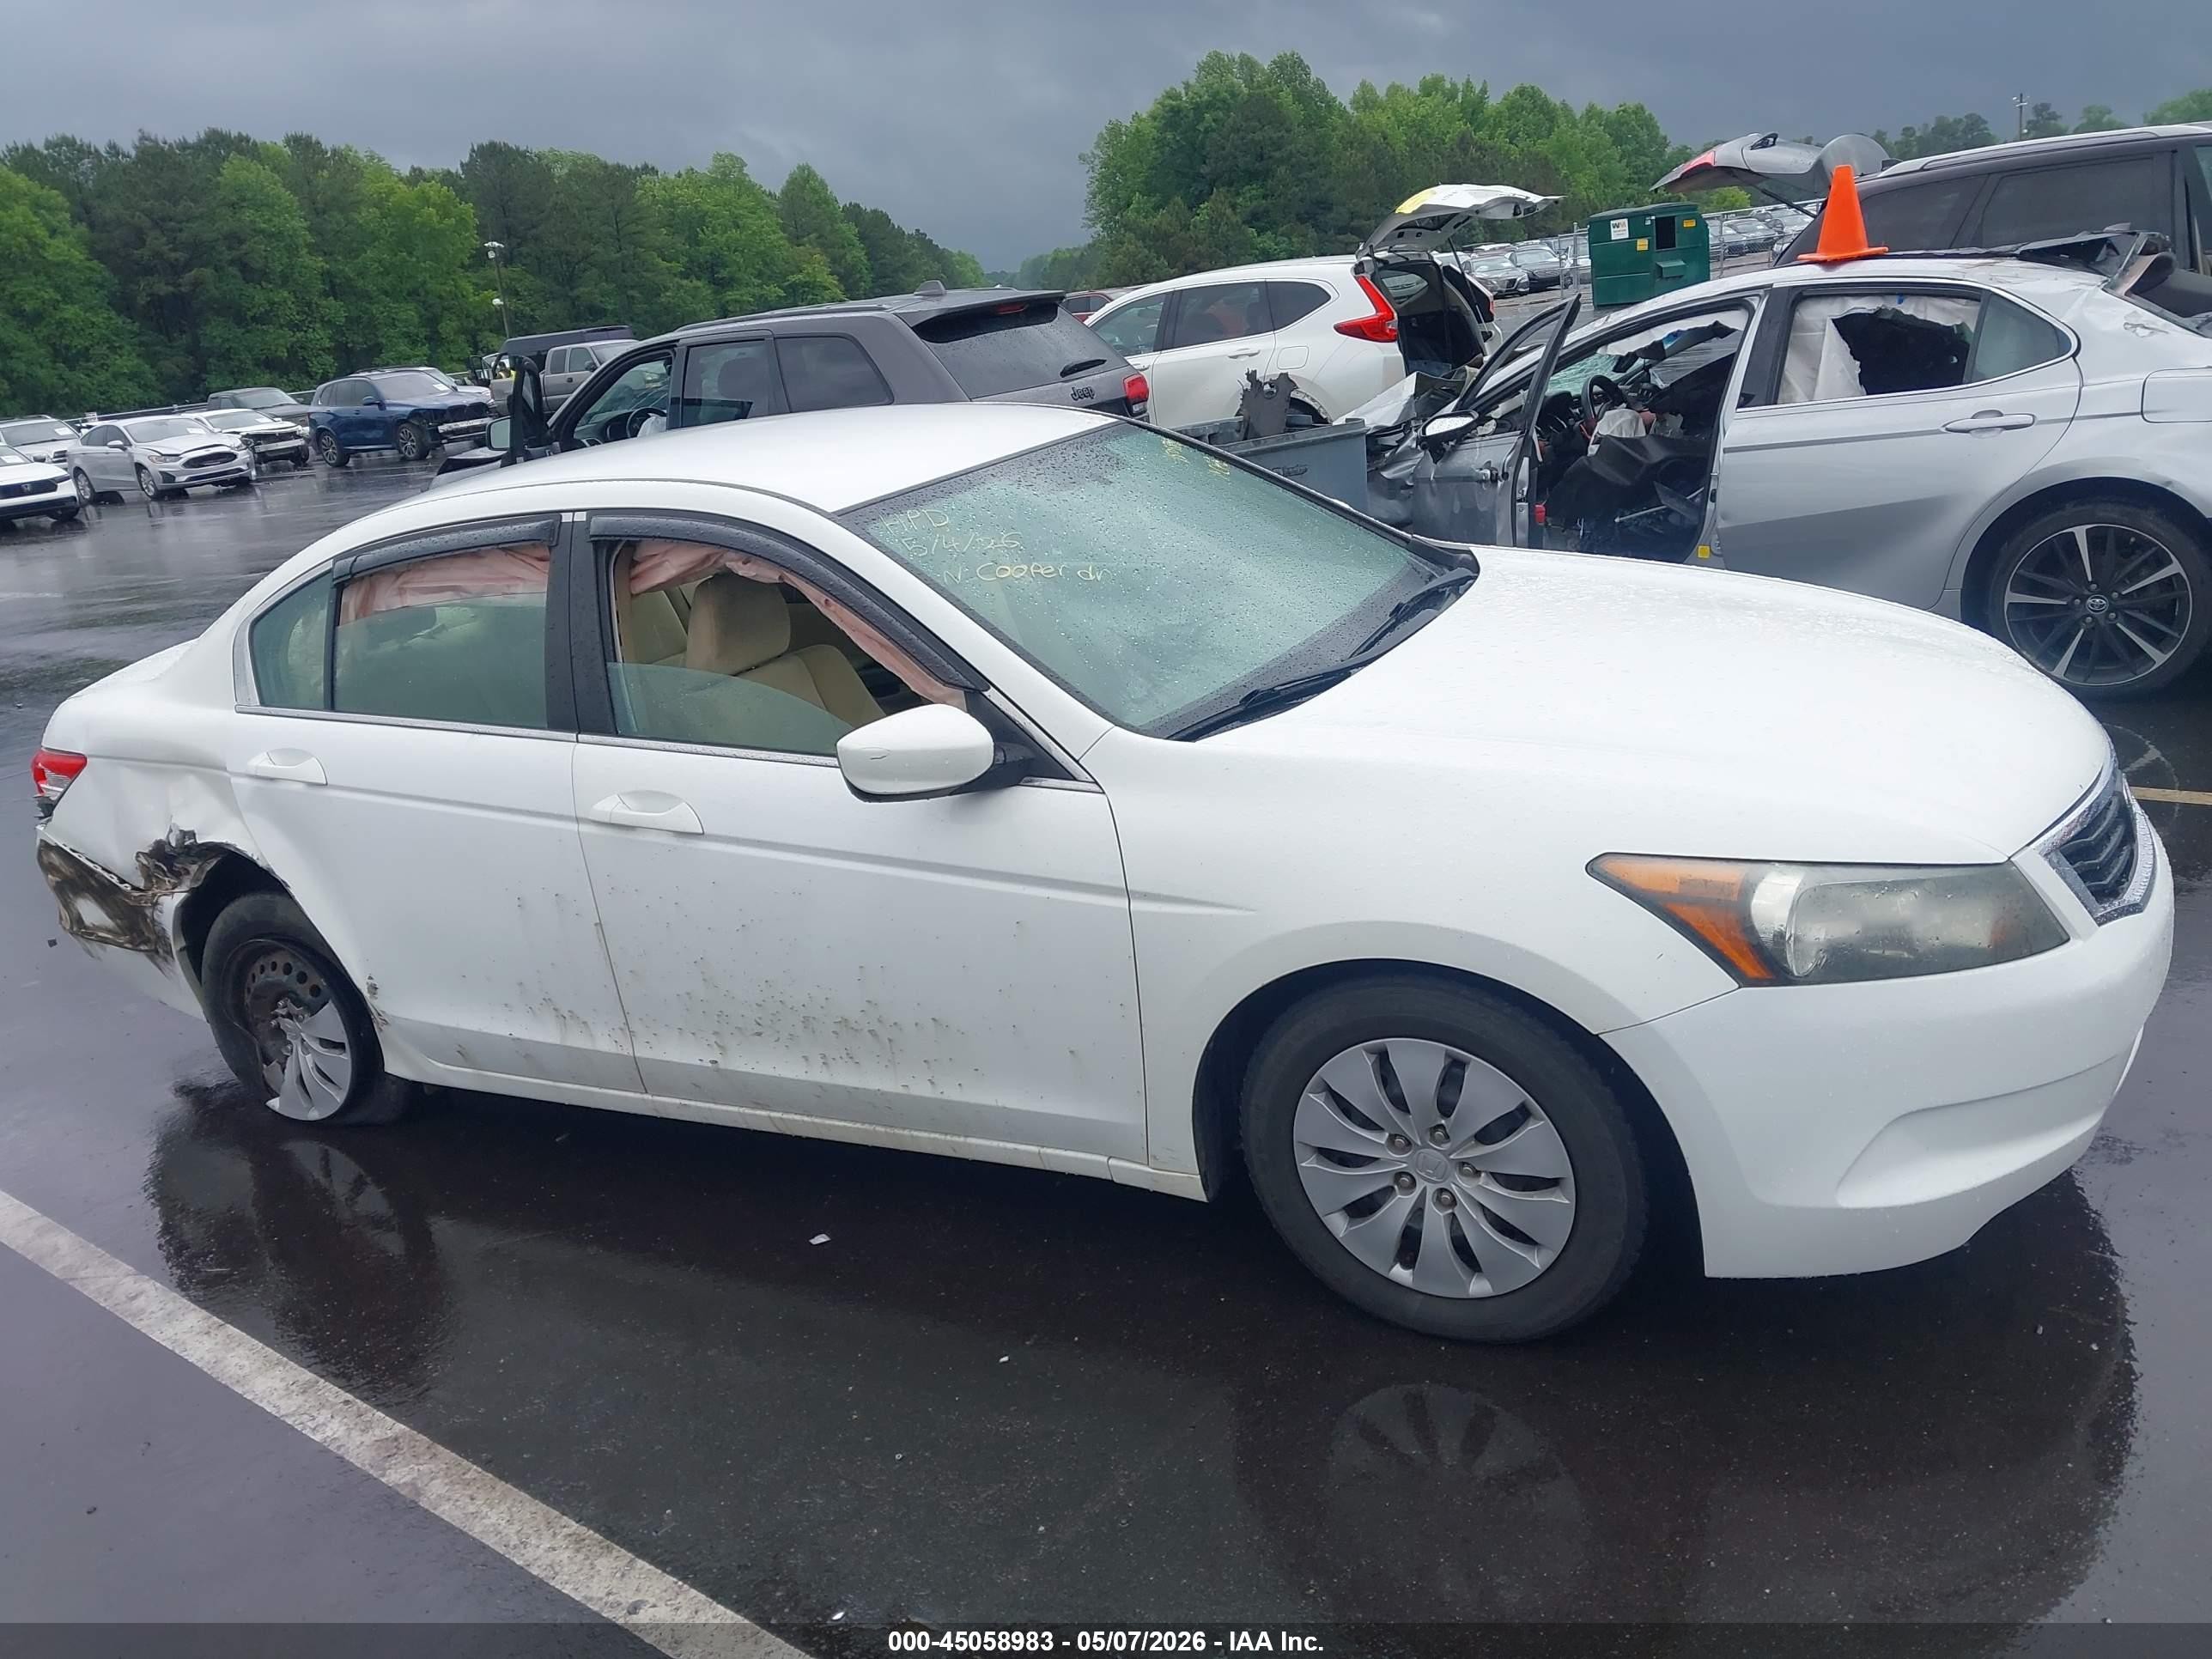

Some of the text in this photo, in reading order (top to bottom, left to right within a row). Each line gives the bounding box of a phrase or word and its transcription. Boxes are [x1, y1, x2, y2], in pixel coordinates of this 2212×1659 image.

[1070, 386, 1096, 402] Jeep
[878, 508, 950, 537] HPD
[901, 531, 1024, 557] 5/4/26
[943, 564, 963, 586] N
